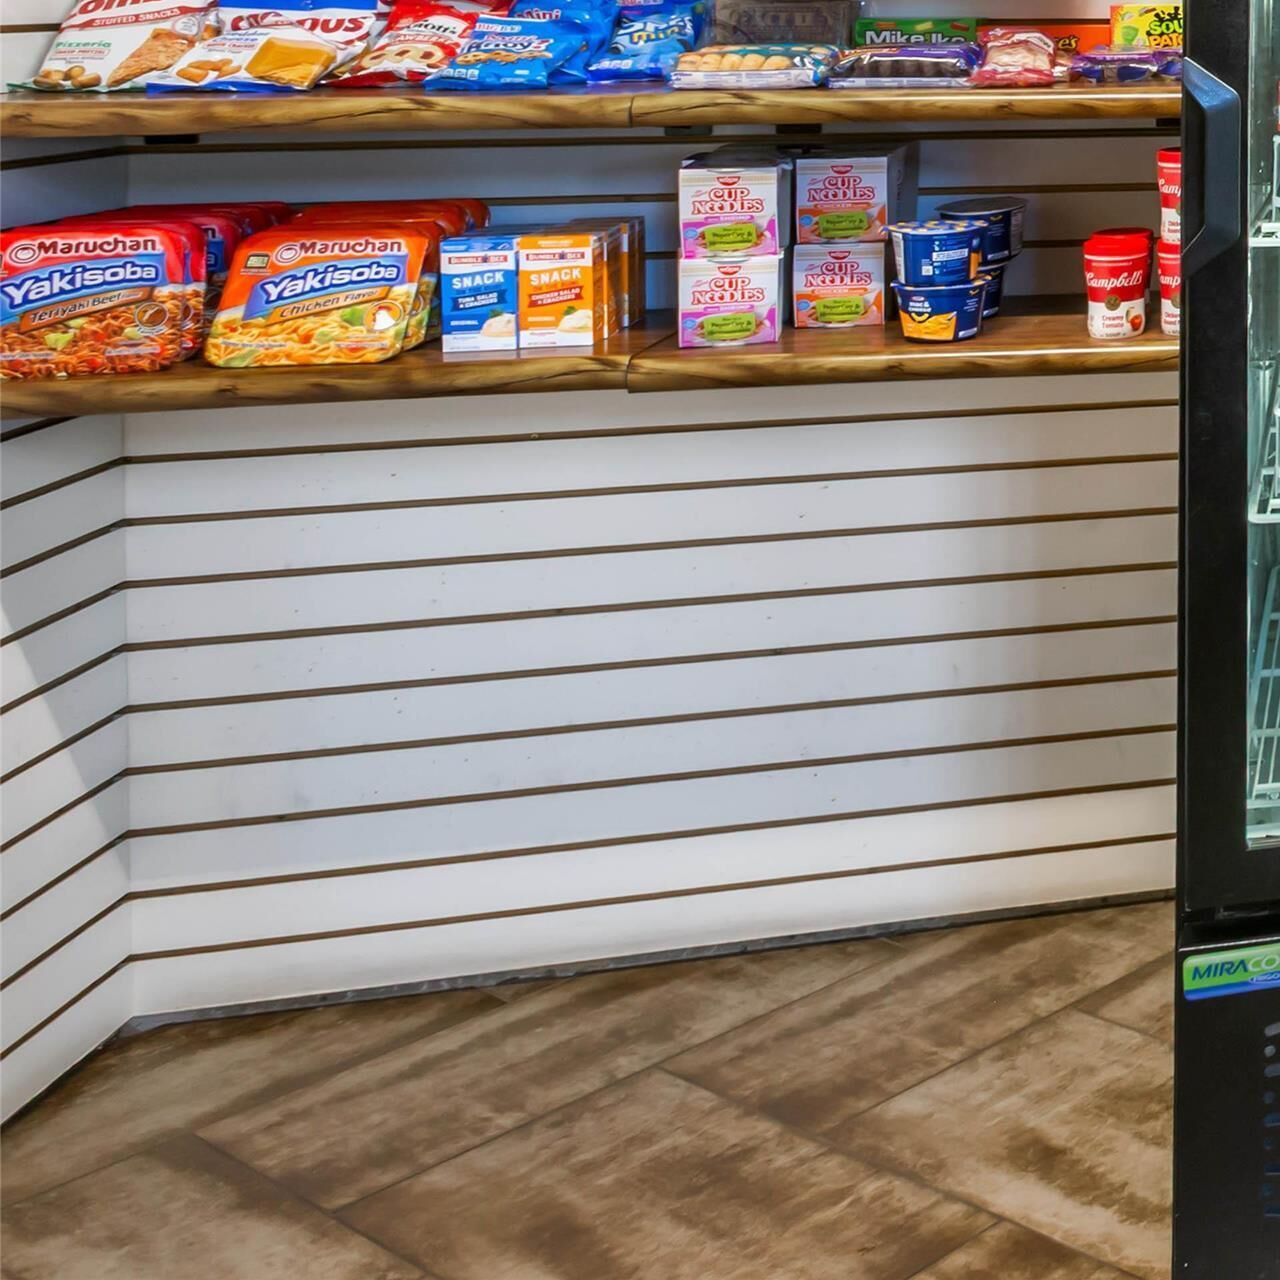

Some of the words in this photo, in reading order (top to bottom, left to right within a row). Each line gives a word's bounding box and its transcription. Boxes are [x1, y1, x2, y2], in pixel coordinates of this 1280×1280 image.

[92, 13, 136, 26] STUFFED
[138, 8, 181, 22] SNACKS
[1149, 19, 1184, 35] SOU
[865, 30, 924, 45] Mike
[1149, 32, 1183, 48] PAT
[823, 175, 862, 189] CUP
[708, 187, 750, 201] CUP
[808, 187, 875, 202] NOODLES
[692, 198, 765, 214] NOODLES
[37, 238, 158, 255] Maruchan
[300, 238, 402, 255] Maruchan
[821, 261, 859, 274] CUP
[263, 262, 399, 307] Yakisoba
[452, 271, 505, 290] SNACK
[529, 267, 582, 286] SNACK
[708, 277, 750, 291] CUP
[804, 272, 872, 288] NOODLES
[1084, 269, 1143, 291] Campbell's
[2, 262, 157, 309] Yakisoba
[280, 297, 339, 318] Chicken
[343, 289, 378, 305] Flavor
[692, 289, 765, 305] NOODLES
[31, 299, 89, 325] Teriyaki
[91, 293, 123, 307] Beef
